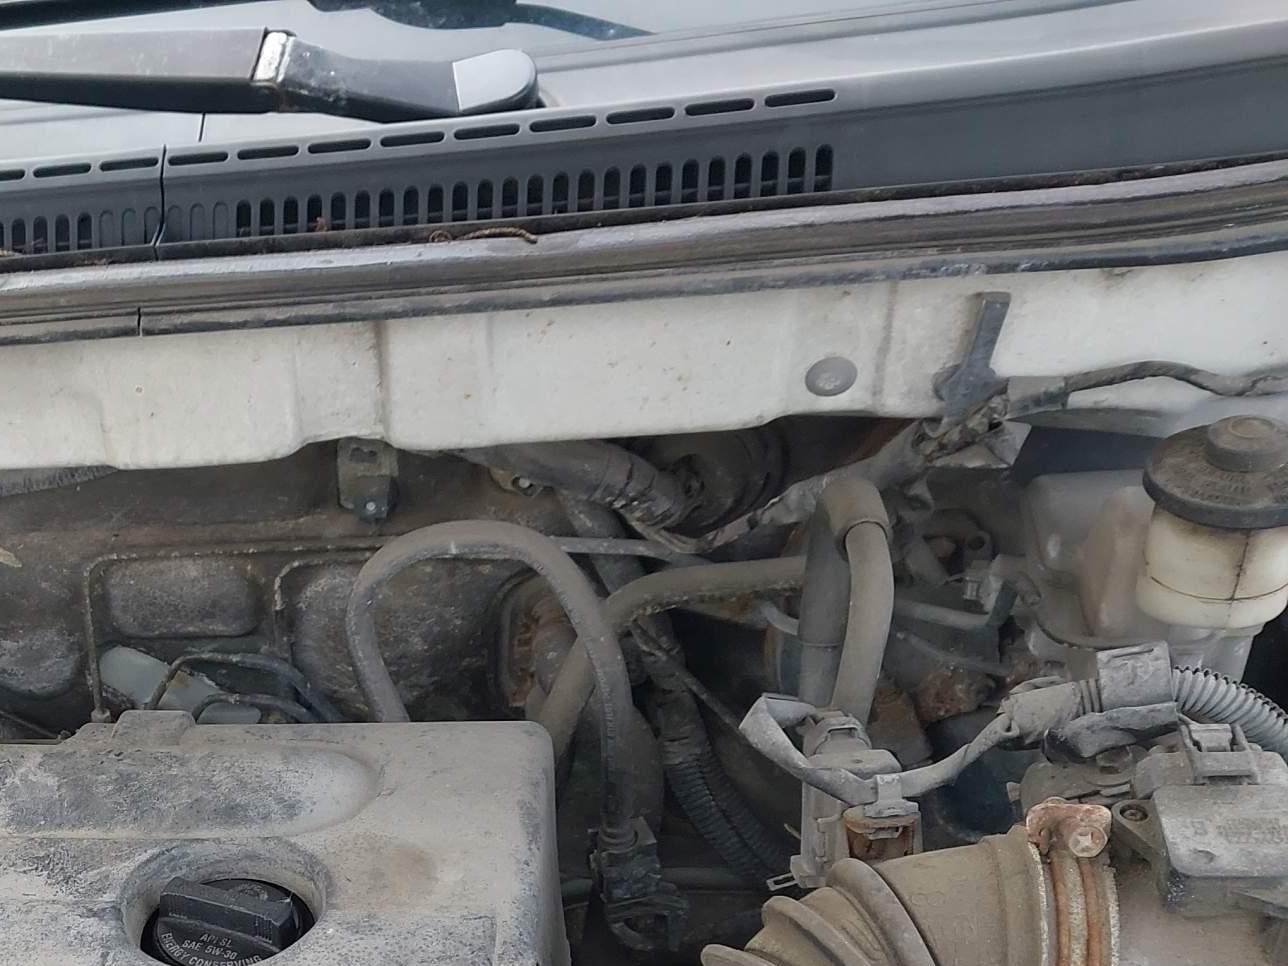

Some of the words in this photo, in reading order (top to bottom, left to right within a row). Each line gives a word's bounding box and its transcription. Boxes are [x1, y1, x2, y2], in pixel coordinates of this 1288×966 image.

[161, 932, 190, 961] ENERGY
[182, 939, 202, 952] SAE
[205, 945, 238, 960] 5W-30
[200, 933, 218, 945] API
[219, 937, 233, 948] SL
